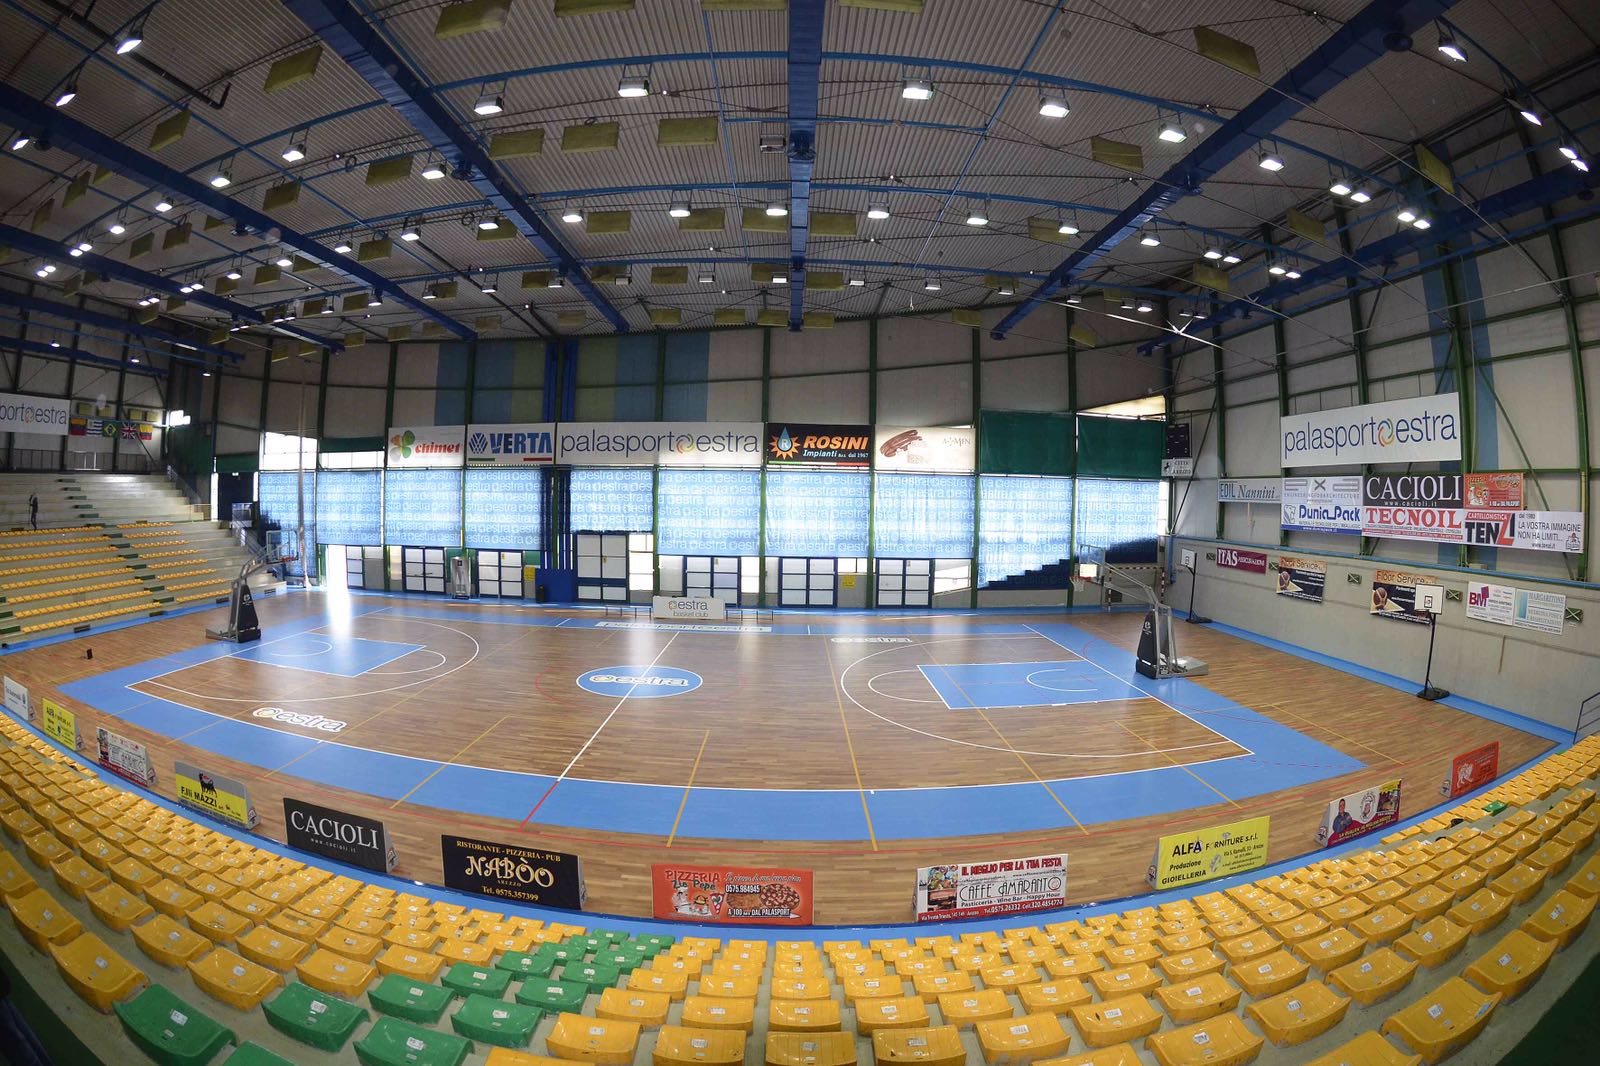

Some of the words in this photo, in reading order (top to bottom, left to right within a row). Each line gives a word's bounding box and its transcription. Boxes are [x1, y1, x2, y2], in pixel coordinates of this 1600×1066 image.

[36, 407, 67, 424] estra
[1395, 410, 1457, 443] estra
[415, 442, 461, 454] chimet
[490, 432, 552, 454] VERTA
[695, 431, 760, 453] estra
[803, 435, 869, 450] ROSINI
[803, 449, 837, 458] Impianti
[1220, 484, 1235, 497] EDIL
[1238, 485, 1275, 499] Nannini
[1366, 476, 1462, 501] CACIOLI
[1366, 508, 1462, 529] TECNOIL
[1518, 521, 1525, 529] LA
[1527, 522, 1550, 530] VOSTRA
[1550, 523, 1581, 532] IMMAGINE
[1465, 513, 1515, 546] TENZI
[1518, 531, 1531, 539] NON
[1532, 532, 1540, 540] HA
[1218, 549, 1238, 566] ITAS
[1376, 570, 1395, 581] Floor
[1397, 573, 1425, 584] Service
[678, 599, 708, 610] estra
[276, 712, 344, 731] estra
[194, 792, 218, 807] MAZZI
[290, 810, 380, 850] CACIOLI
[310, 837, 356, 854] www.cacioli.it
[456, 840, 501, 854] RISTORANTE
[506, 848, 542, 859] PIZZERIA
[546, 854, 561, 862] PUB
[1172, 840, 1202, 858] ALFA
[962, 866, 969, 876] IL
[971, 863, 998, 876] MEGLIO
[999, 861, 1013, 872] PER
[1015, 861, 1024, 870] LA
[1026, 859, 1040, 869] TUA
[1041, 857, 1062, 868] FESTA
[1170, 860, 1202, 872] Produzione
[665, 870, 720, 883] PIZZERIA
[693, 879, 716, 890] Pepe
[1162, 870, 1207, 885] GIOIELLERIA
[482, 886, 495, 894] Tel.
[998, 877, 1062, 897] AMARANTO
[752, 908, 761, 916] DAL
[761, 908, 790, 916] PALASPORT
